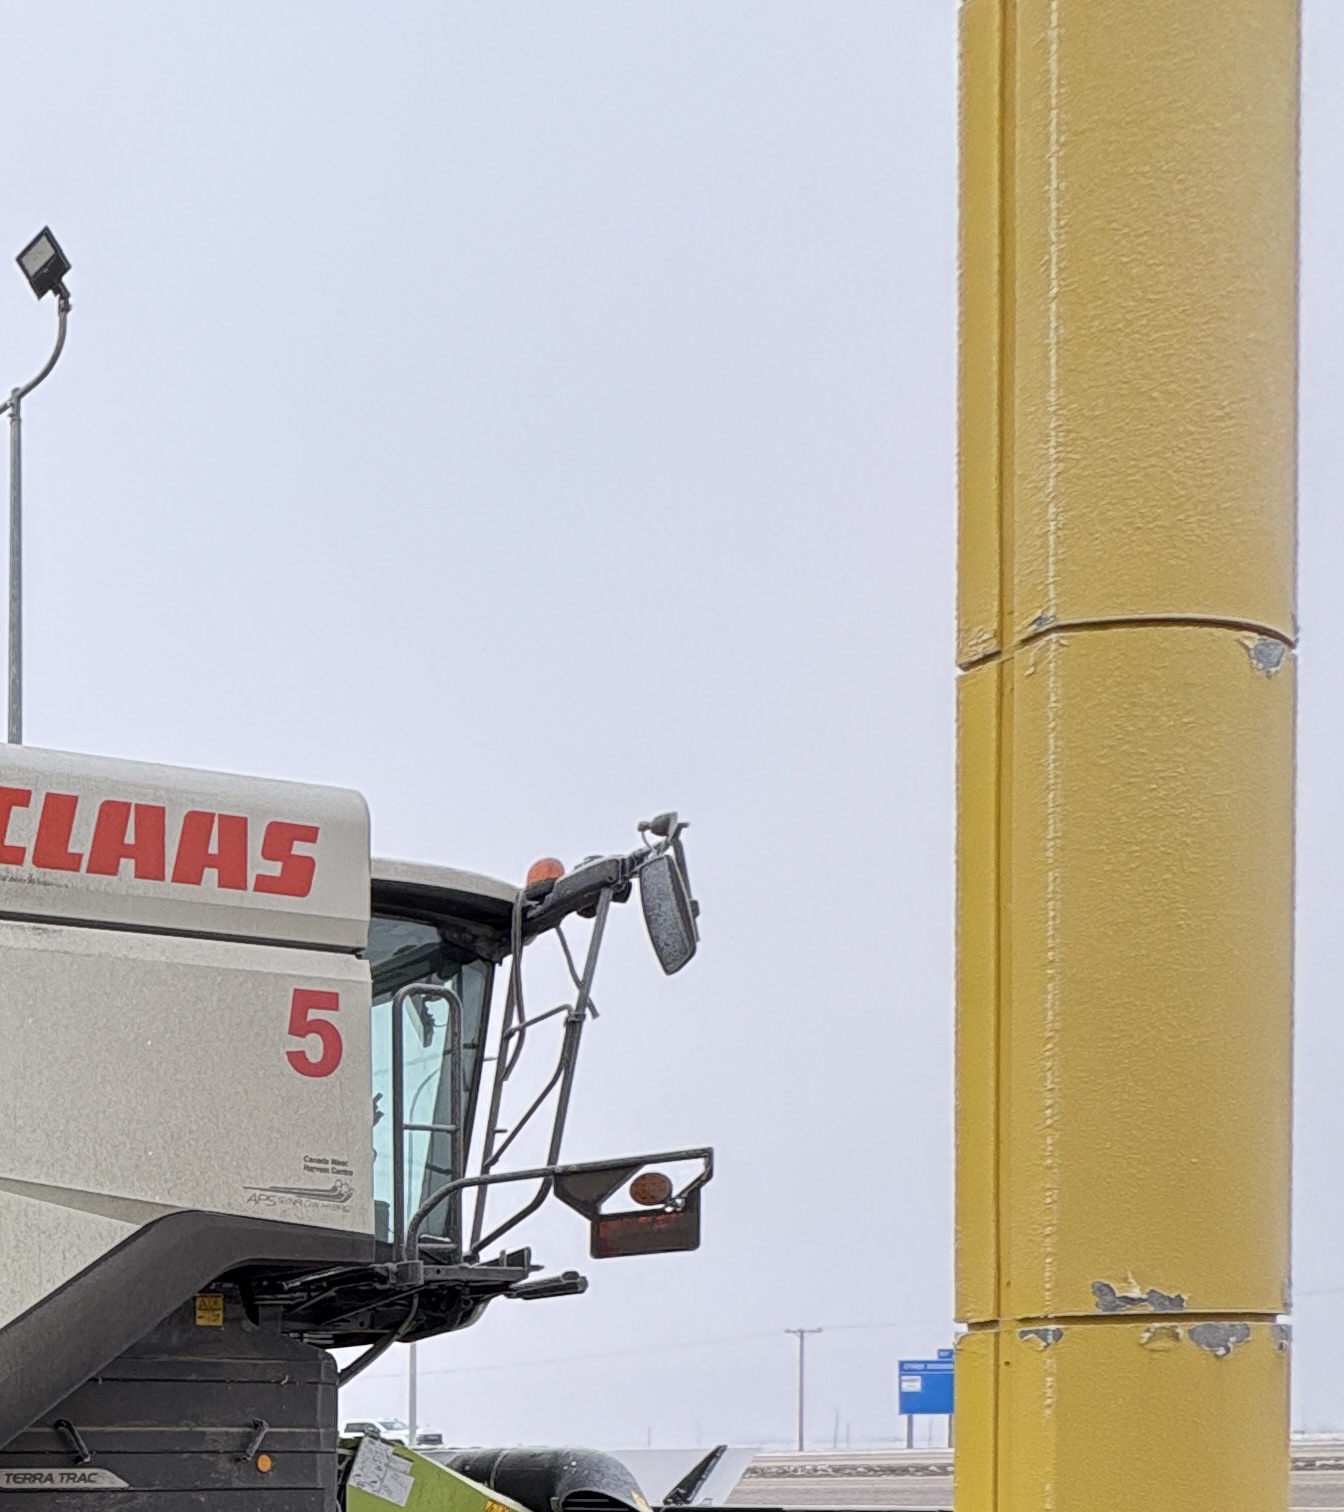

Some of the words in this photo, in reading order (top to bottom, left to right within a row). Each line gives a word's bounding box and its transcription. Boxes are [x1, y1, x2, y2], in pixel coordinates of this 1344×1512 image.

[285, 987, 344, 1078] 5
[246, 1192, 278, 1207] APS
[4, 1472, 55, 1485] TERRA
[58, 1472, 99, 1485] TRAC
